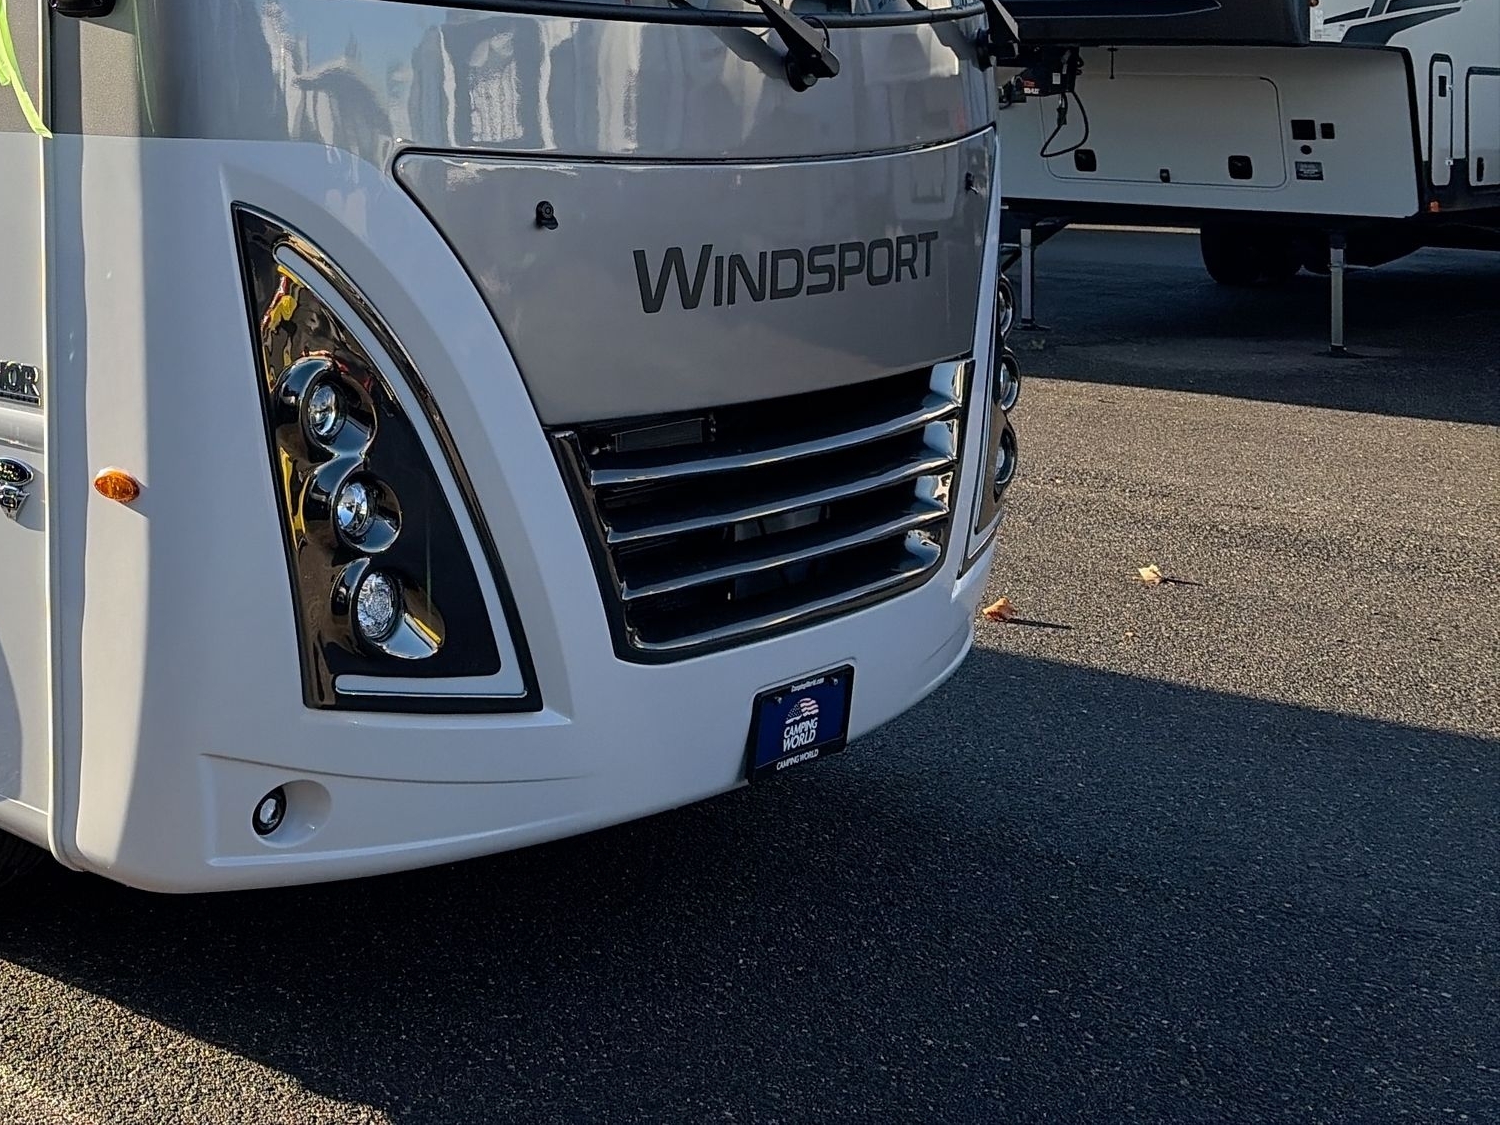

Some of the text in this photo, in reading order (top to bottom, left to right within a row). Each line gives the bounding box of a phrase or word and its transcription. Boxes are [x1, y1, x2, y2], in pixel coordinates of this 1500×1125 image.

[632, 230, 939, 314] WINDSPORT
[784, 717, 818, 738] CAMPING
[783, 730, 816, 752] WORLD
[776, 749, 819, 771] CAMPING WORLD
